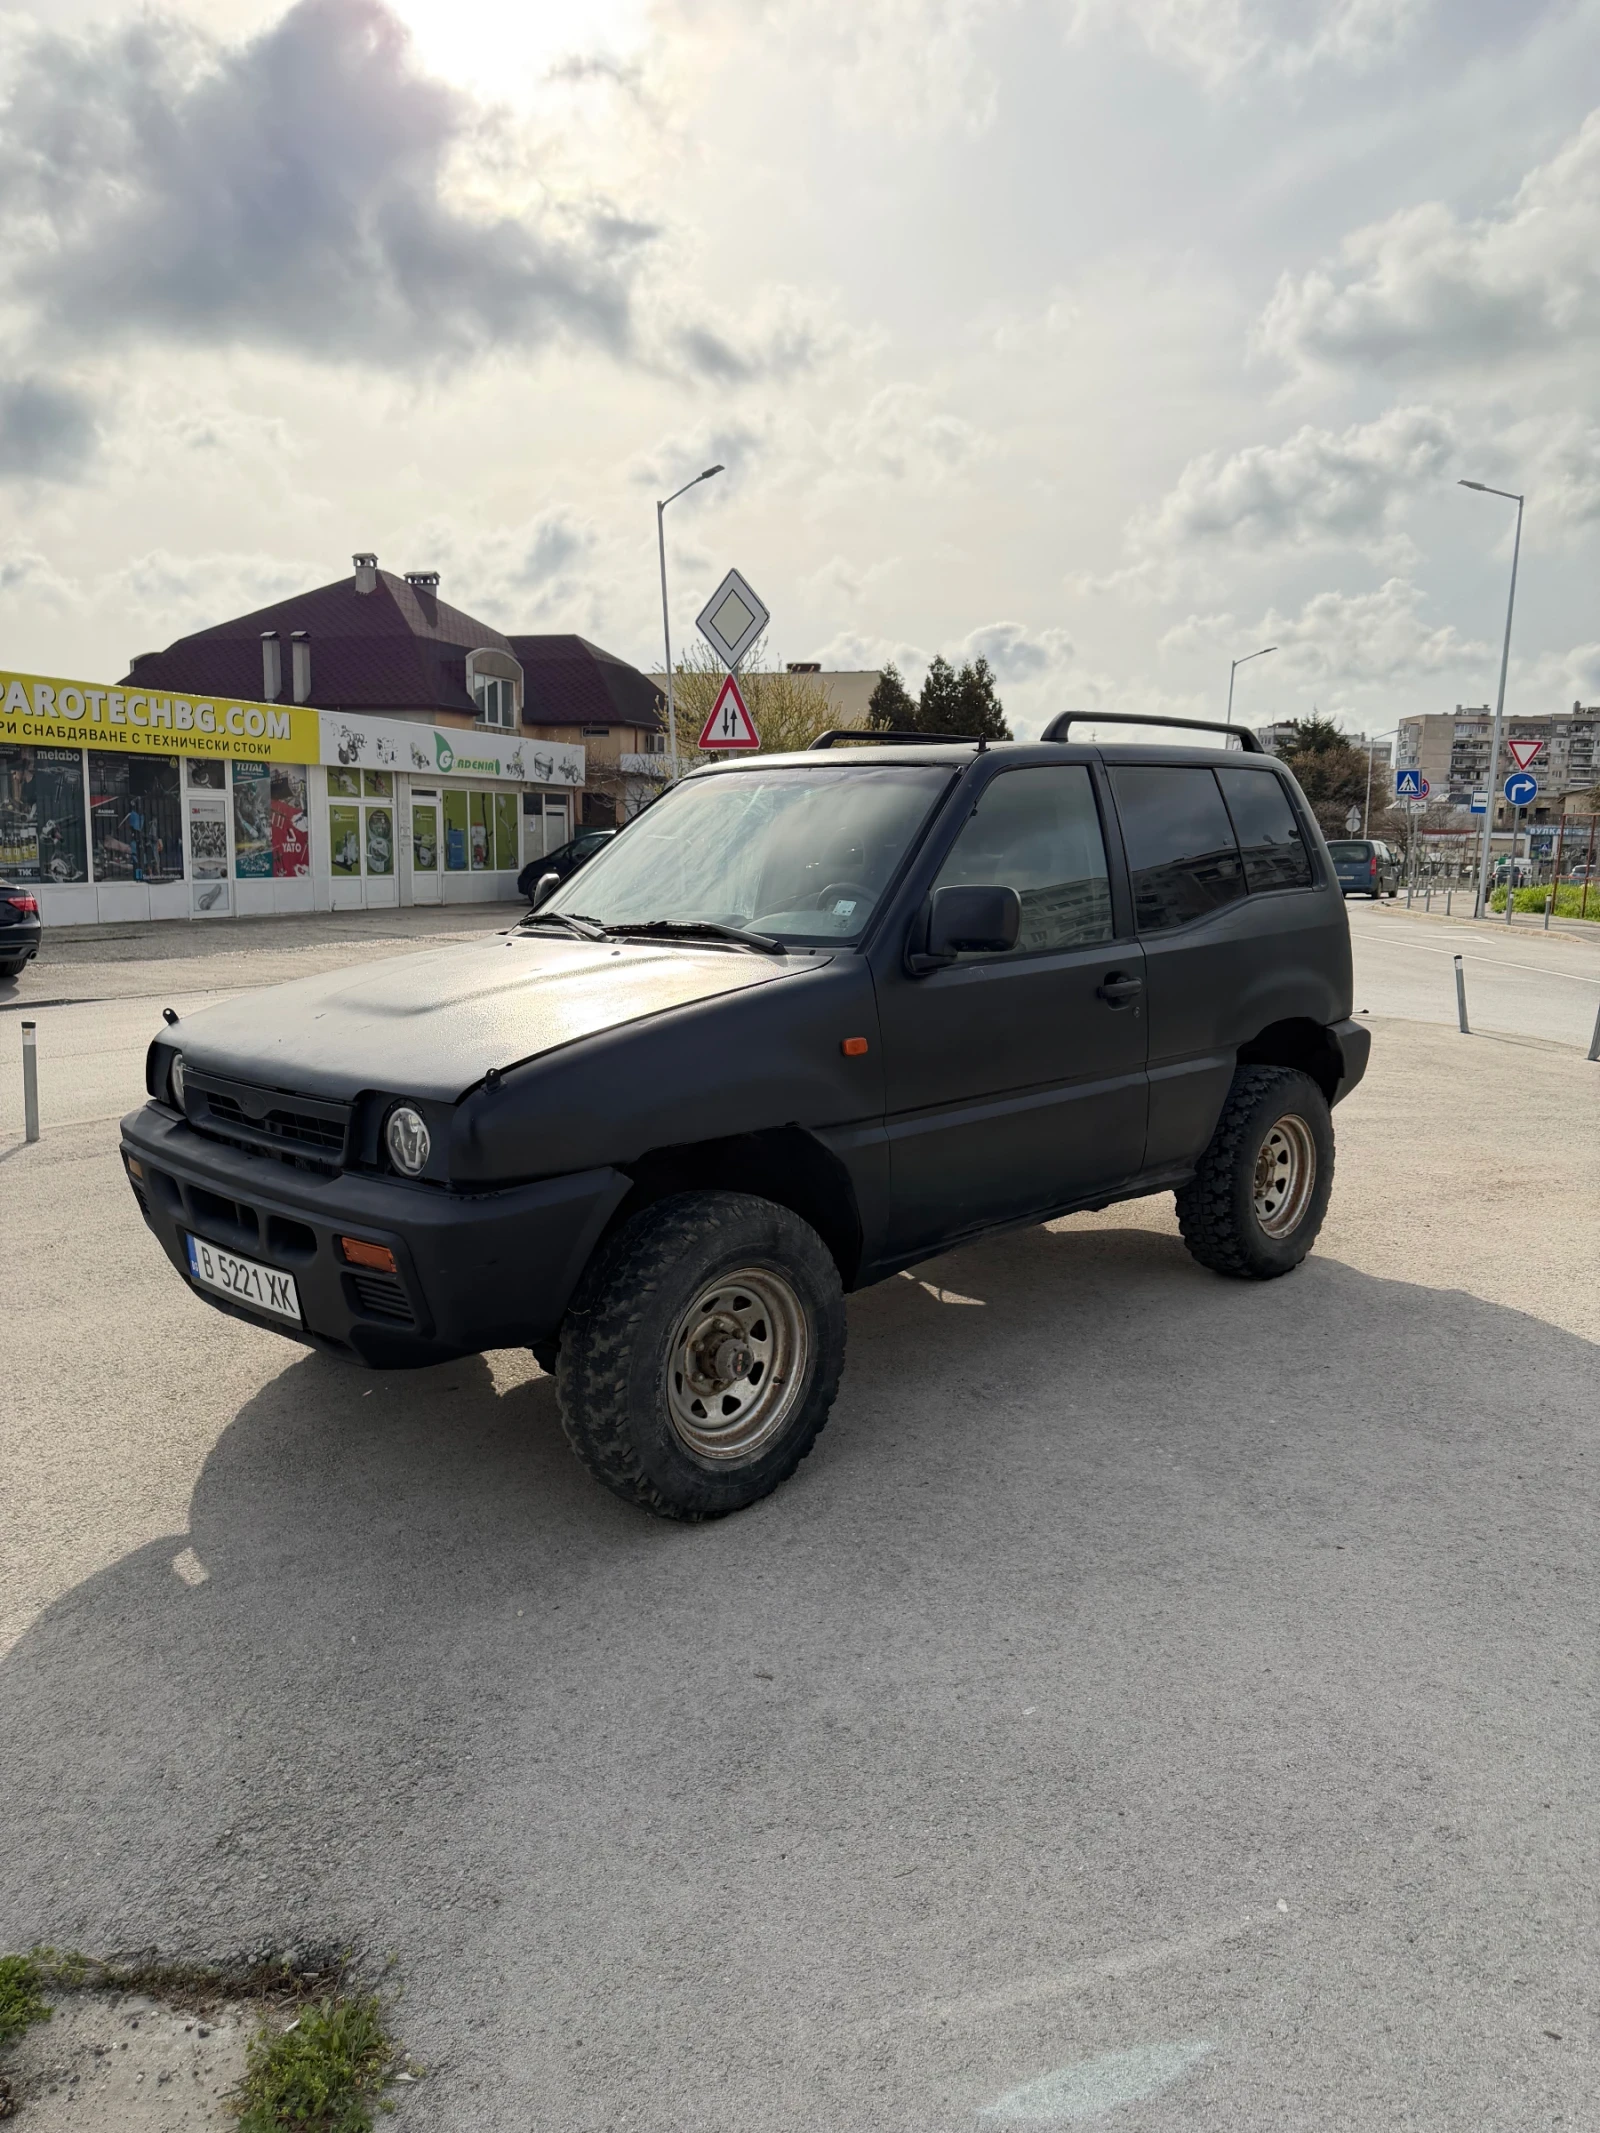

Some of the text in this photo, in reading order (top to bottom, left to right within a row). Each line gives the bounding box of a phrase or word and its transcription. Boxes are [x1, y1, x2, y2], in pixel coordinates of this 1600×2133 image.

[0, 681, 291, 740] AROTECHBG.COM
[22, 723, 127, 743] СНАБДЯВАНЕ
[131, 732, 141, 744] С
[144, 733, 230, 752] ТЕХНИЧЕСКИ
[233, 741, 271, 755] СТОКИ
[36, 749, 80, 761] metabo
[1529, 827, 1569, 836] ВУЛКАН
[282, 843, 302, 853] YATO
[201, 1245, 296, 1313] B 5221 XK
